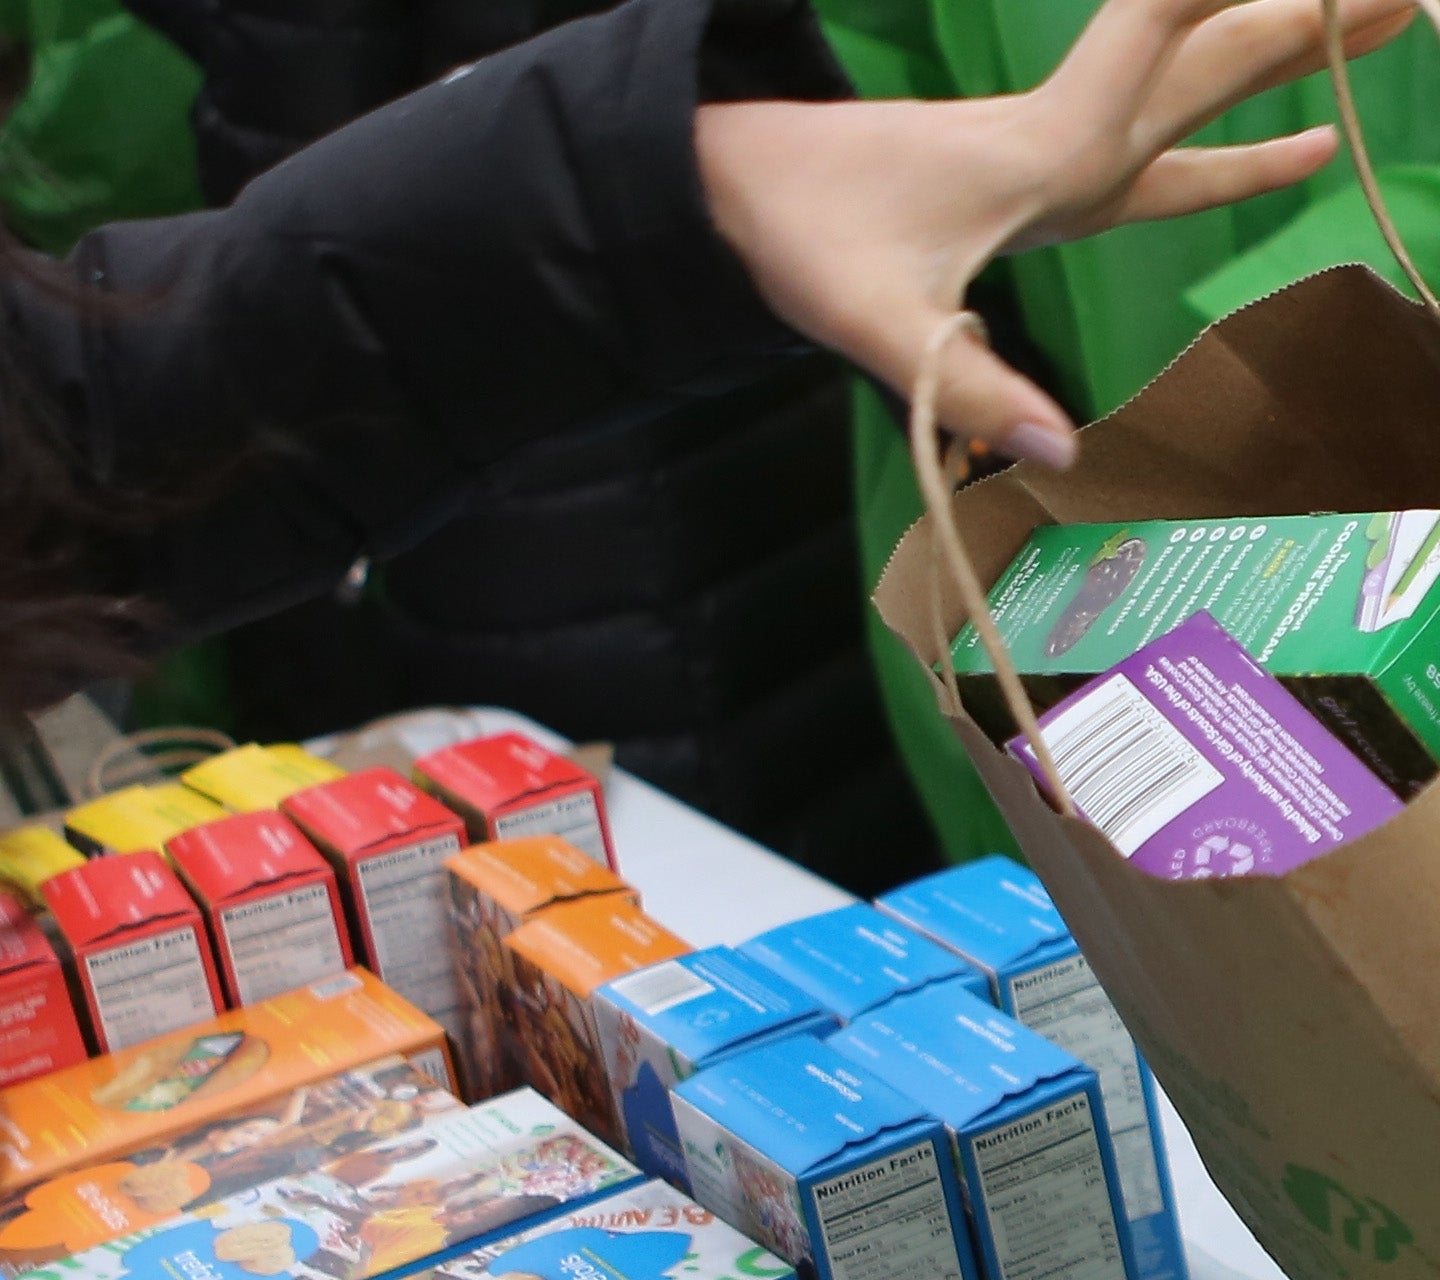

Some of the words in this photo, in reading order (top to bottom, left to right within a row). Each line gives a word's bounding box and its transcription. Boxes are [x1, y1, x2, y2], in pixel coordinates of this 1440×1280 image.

[1309, 521, 1359, 580] COOKIE
[1254, 582, 1318, 662] PROGRAM
[1141, 663, 1169, 689] USA.
[1159, 682, 1183, 703] the
[1174, 697, 1192, 712] of
[1183, 706, 1220, 740] Scouts
[1210, 734, 1235, 755] Girl
[1225, 750, 1245, 765] of
[1236, 758, 1285, 803] authority
[1273, 797, 1298, 815] by
[1283, 809, 1324, 844] Baked
[974, 1116, 1042, 1153] Nutrition
[1046, 1097, 1086, 1123] Facts
[816, 1165, 885, 1200] Nutrition
[889, 1147, 931, 1171] Facts
